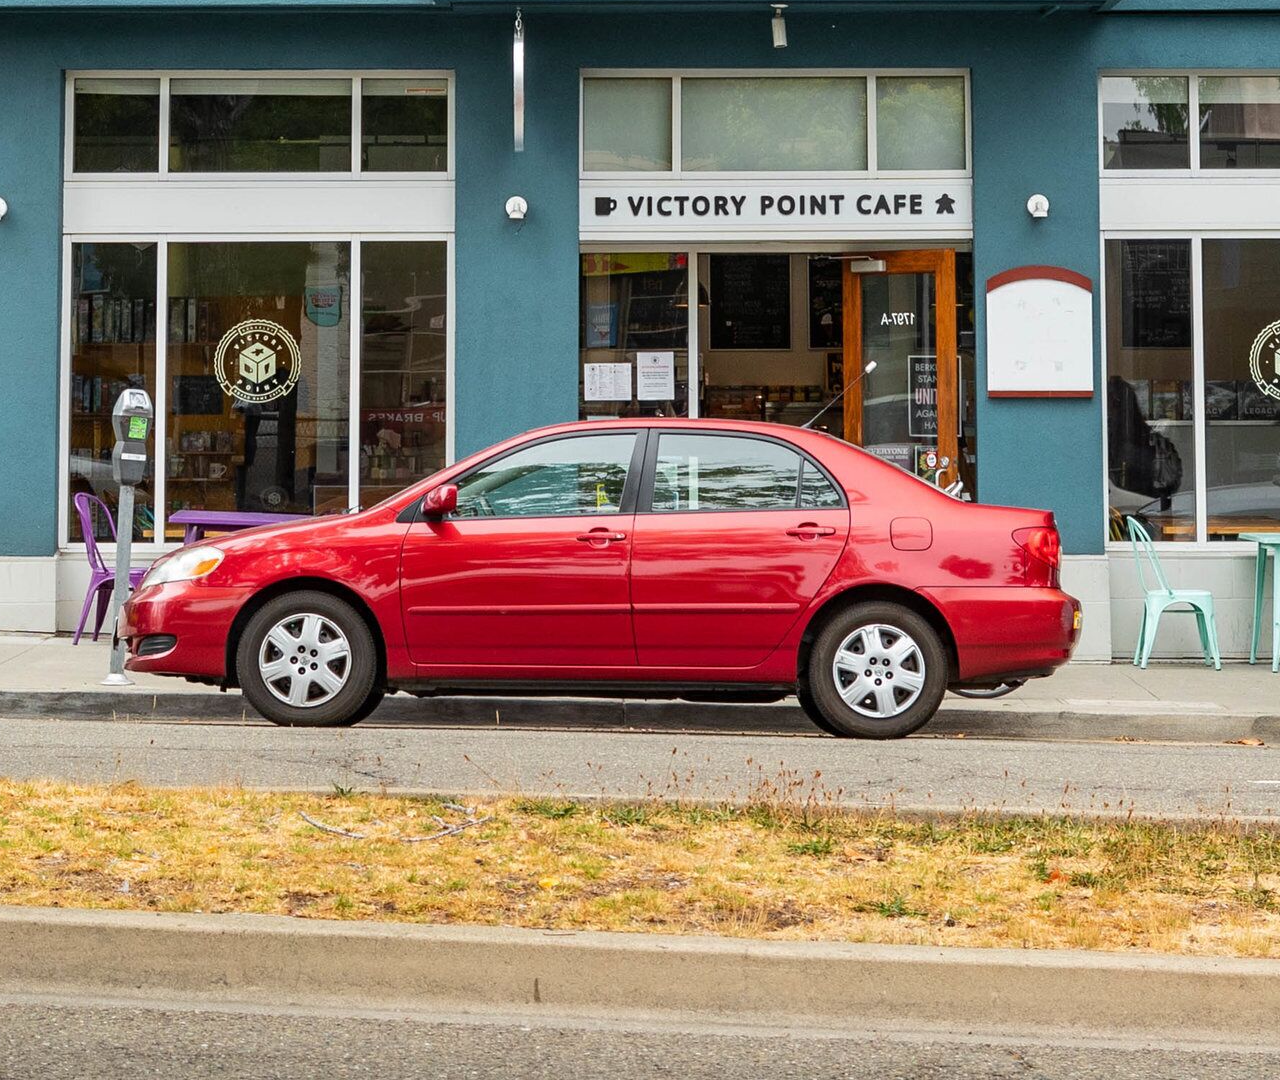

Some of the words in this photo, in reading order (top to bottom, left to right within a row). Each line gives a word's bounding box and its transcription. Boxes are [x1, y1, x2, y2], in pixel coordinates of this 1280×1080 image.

[627, 195, 747, 217] VICTORY
[760, 194, 845, 216] POINT
[856, 194, 923, 215] CAFE
[233, 333, 283, 351] VICTORY
[915, 363, 937, 372] BERK
[236, 378, 278, 393] POINT
[918, 375, 937, 383] STAN
[915, 388, 937, 405] UNIT
[915, 409, 937, 418] AGAI
